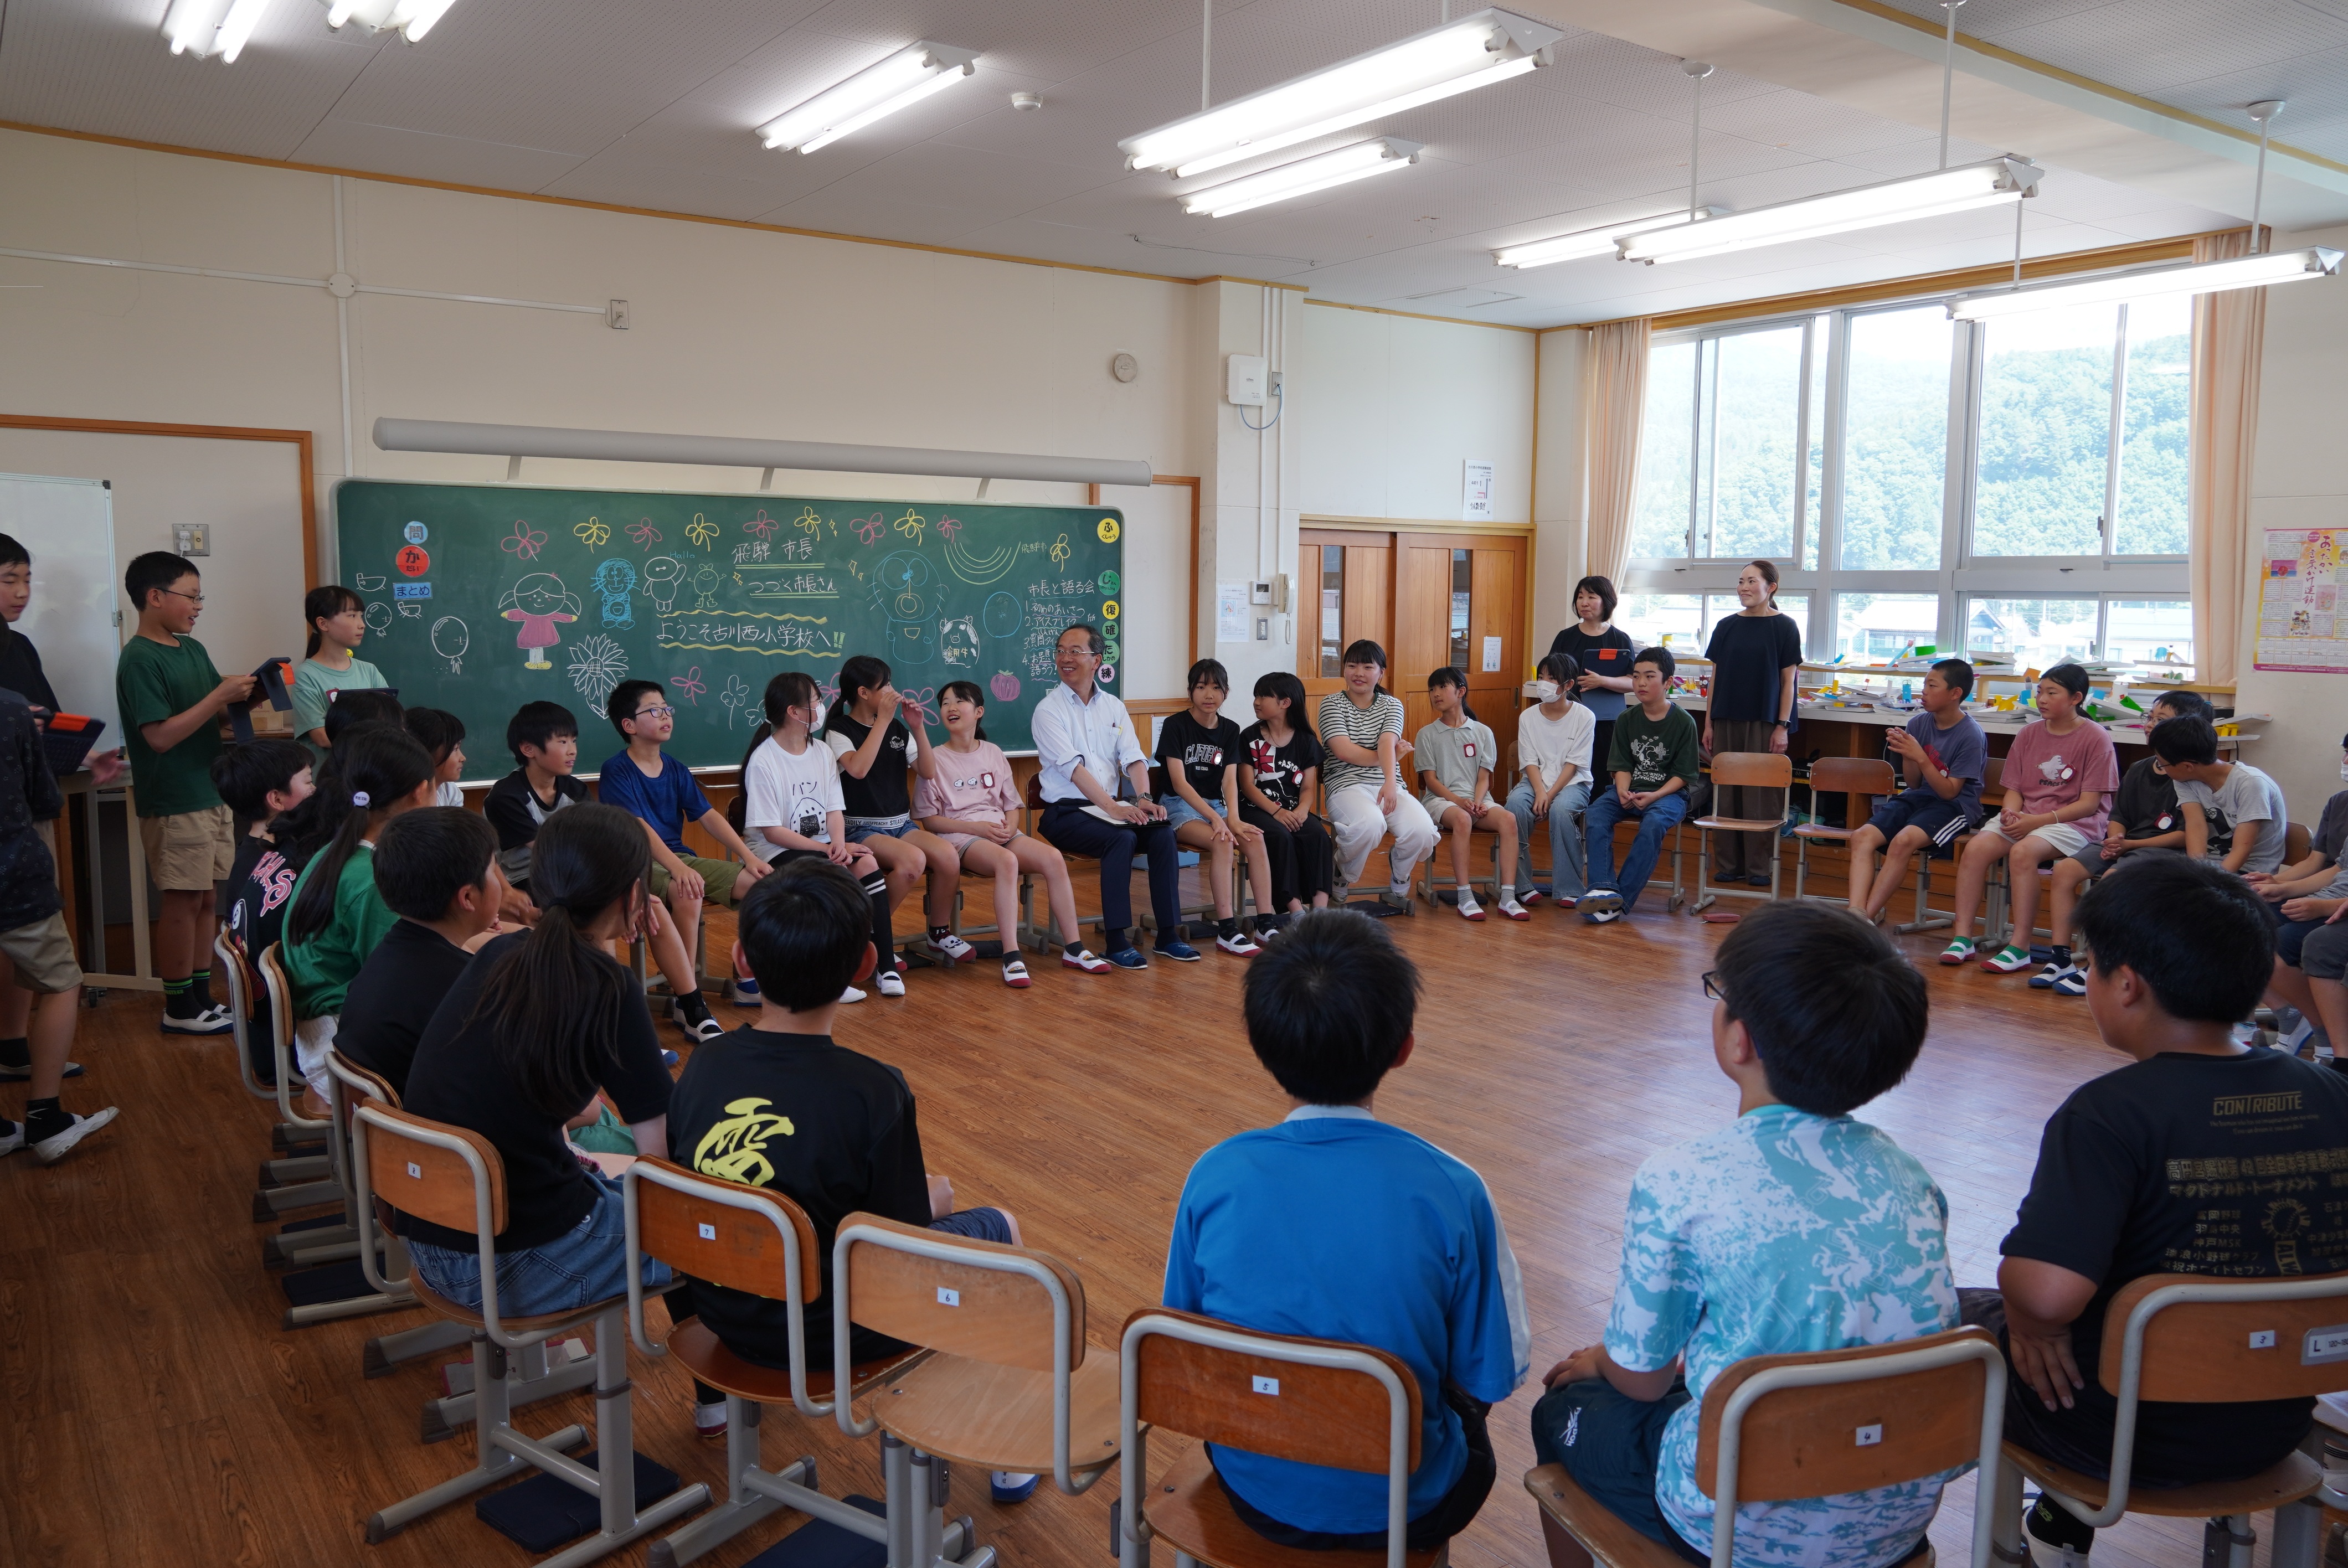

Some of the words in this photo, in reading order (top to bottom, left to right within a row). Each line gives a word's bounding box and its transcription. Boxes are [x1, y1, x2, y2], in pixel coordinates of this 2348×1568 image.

[409, 525, 424, 540] 問
[1104, 522, 1113, 533] ふ
[781, 538, 812, 561] 市長
[405, 550, 420, 564] か
[396, 585, 430, 597] まとめ
[1028, 580, 1094, 597] 市長と語る会
[1106, 604, 1116, 615] 復
[1105, 625, 1115, 635] 確
[948, 646, 968, 658] 食用牛
[1101, 668, 1111, 679] 練
[1281, 760, 1300, 773] ASTO
[792, 781, 817, 796] パン
[2213, 1091, 2303, 1116] CONTRIBUTE
[945, 1294, 951, 1302] 6
[2259, 1335, 2266, 1344] 3
[2314, 1340, 2321, 1352] L
[1864, 1433, 1871, 1442] 4
